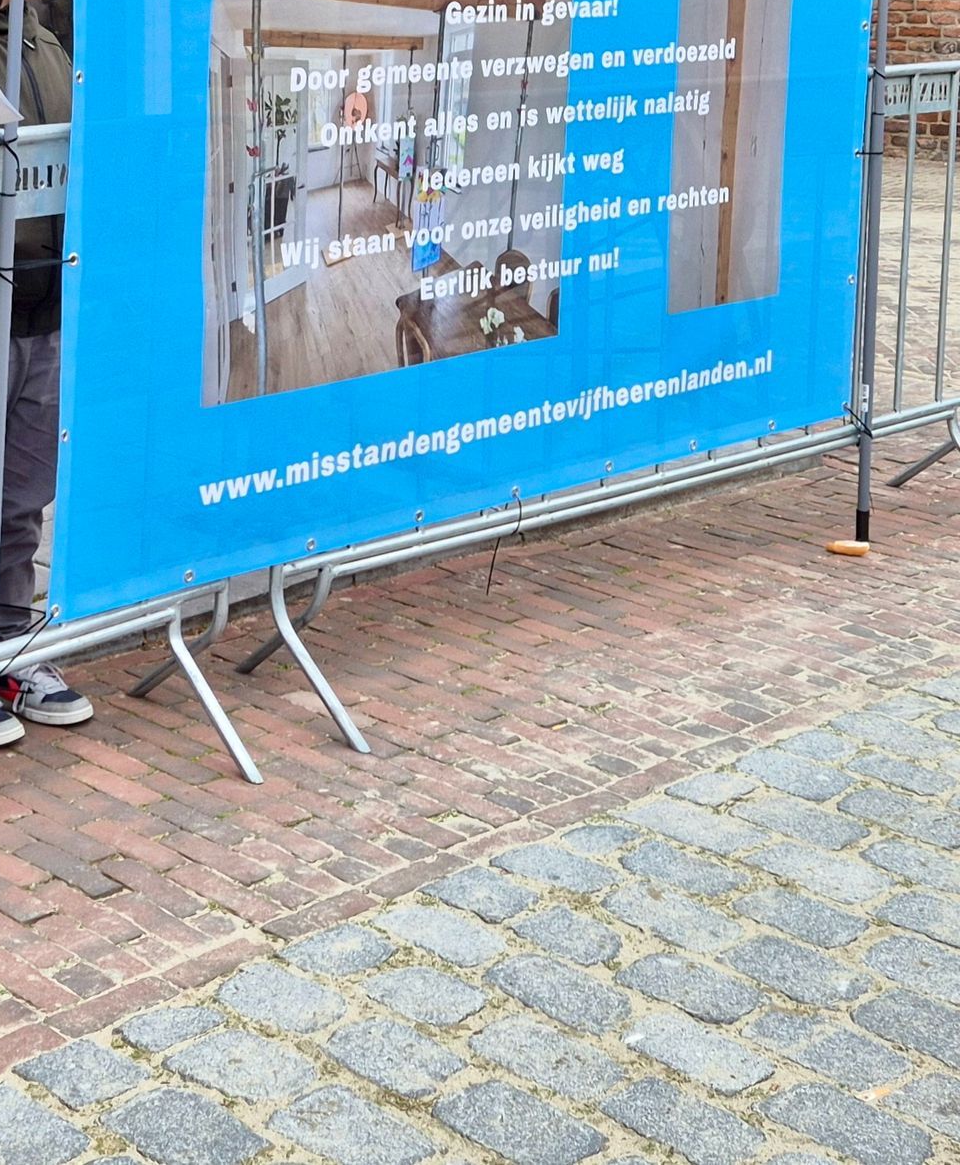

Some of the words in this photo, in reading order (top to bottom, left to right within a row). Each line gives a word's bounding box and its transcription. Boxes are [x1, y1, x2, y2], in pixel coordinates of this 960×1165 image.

[445, 0, 508, 25] Gezin
[290, 66, 349, 92] Door
[356, 56, 473, 94] gemeente
[481, 51, 594, 78] verzwegen
[601, 49, 626, 68] en
[632, 38, 736, 66] verdoezeld
[320, 116, 416, 147] Ontkent
[424, 110, 478, 138] alles
[487, 111, 512, 131] en
[520, 105, 538, 127] is
[546, 94, 638, 123] wettelijk
[644, 89, 710, 116] nalatig
[422, 162, 520, 192] Iedereen
[528, 151, 576, 182] kijkt
[582, 148, 625, 174] weg
[280, 237, 320, 269] Wij
[328, 233, 395, 260] staan
[404, 224, 454, 248] voor
[461, 217, 513, 240] onze
[520, 197, 621, 231] veiligheid
[628, 197, 651, 216] en
[657, 185, 729, 212] rechten
[420, 266, 493, 301] Eerlijk
[500, 256, 582, 287] bestuur
[589, 247, 620, 272] nu!
[198, 349, 773, 506] www.misstandengemeentevijfheerenlanden.nl
